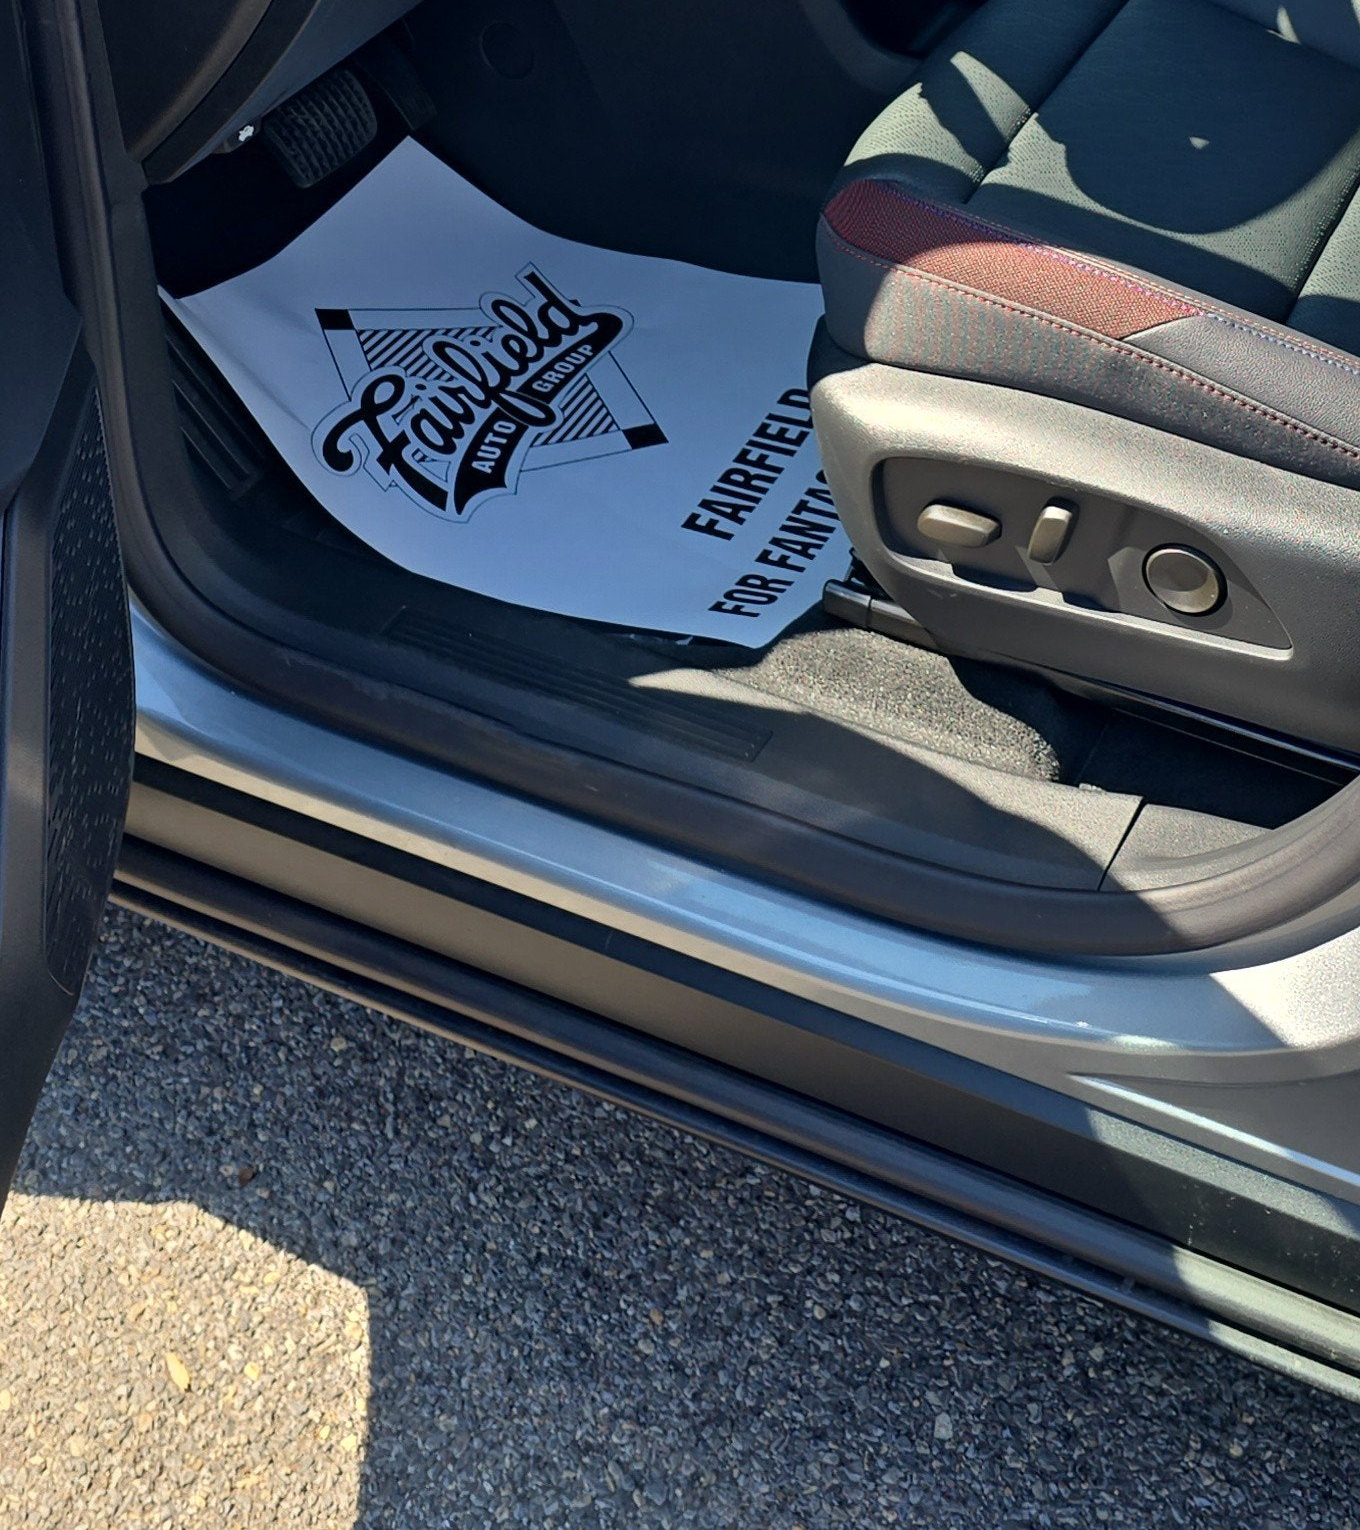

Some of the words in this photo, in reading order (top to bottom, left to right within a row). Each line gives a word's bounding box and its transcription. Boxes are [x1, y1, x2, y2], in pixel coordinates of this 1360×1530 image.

[322, 271, 624, 512] Fairfield
[470, 421, 516, 474] AUTO
[532, 344, 594, 394] GROUP
[681, 388, 814, 541] FAIRFIELD
[707, 574, 795, 618] FOR
